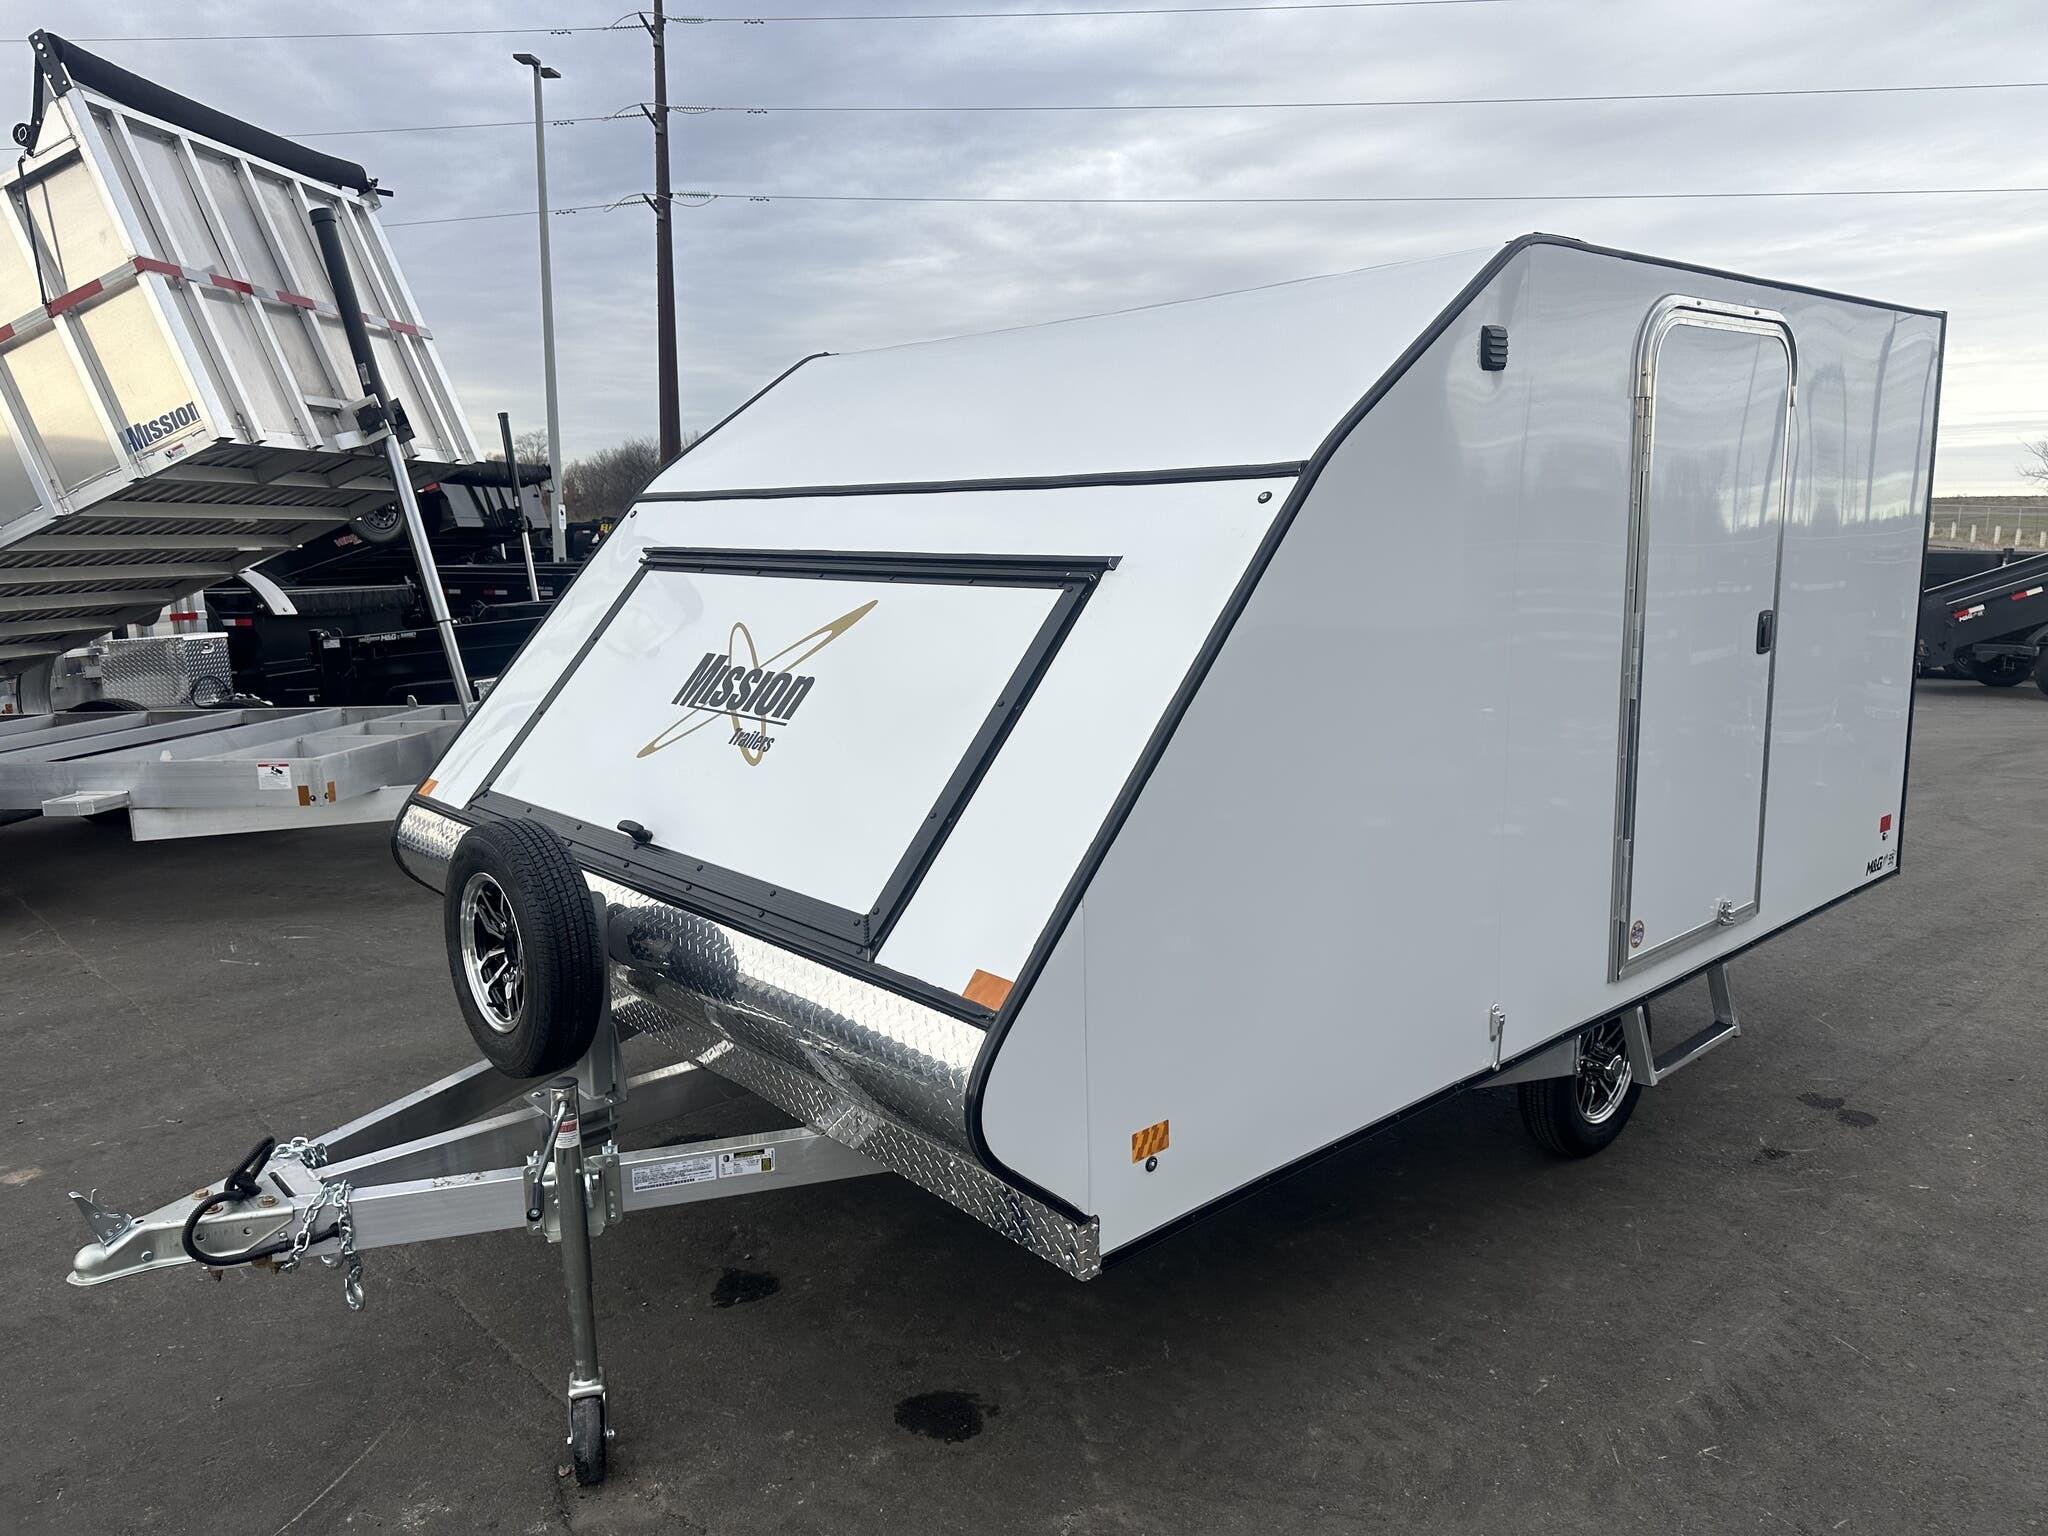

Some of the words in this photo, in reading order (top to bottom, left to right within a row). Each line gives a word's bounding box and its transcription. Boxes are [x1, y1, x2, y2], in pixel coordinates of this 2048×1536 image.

[125, 400, 201, 453] Mission
[671, 652, 815, 720] Mission
[728, 728, 775, 753] Trailers
